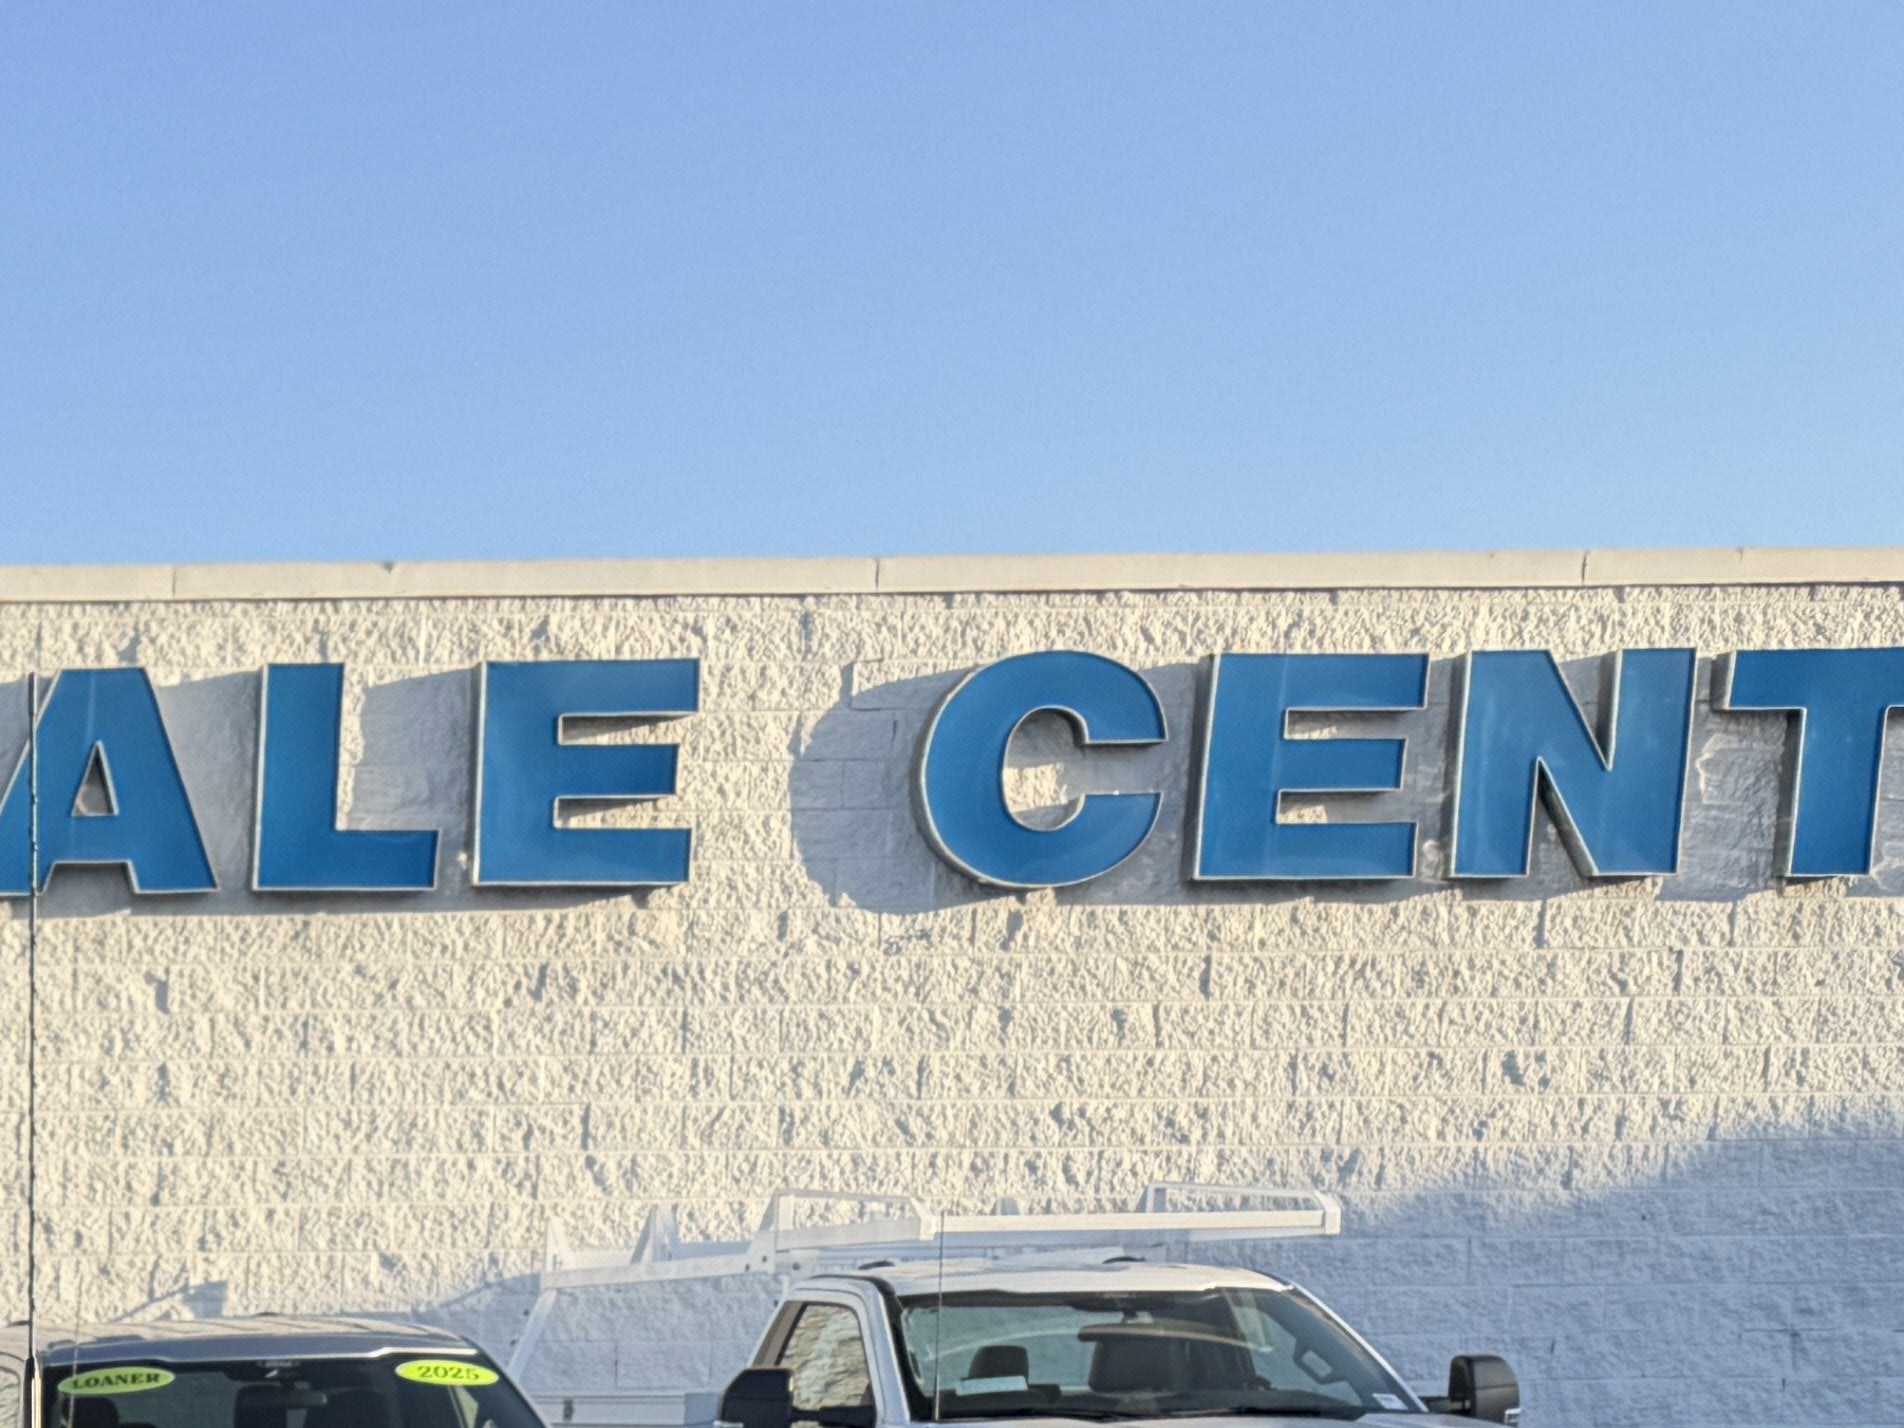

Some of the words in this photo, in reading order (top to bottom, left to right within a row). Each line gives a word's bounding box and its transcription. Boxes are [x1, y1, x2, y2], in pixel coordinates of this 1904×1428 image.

[919, 647, 1904, 887] CENT
[417, 1365, 480, 1380] 2025
[71, 1373, 160, 1390] LOANER
